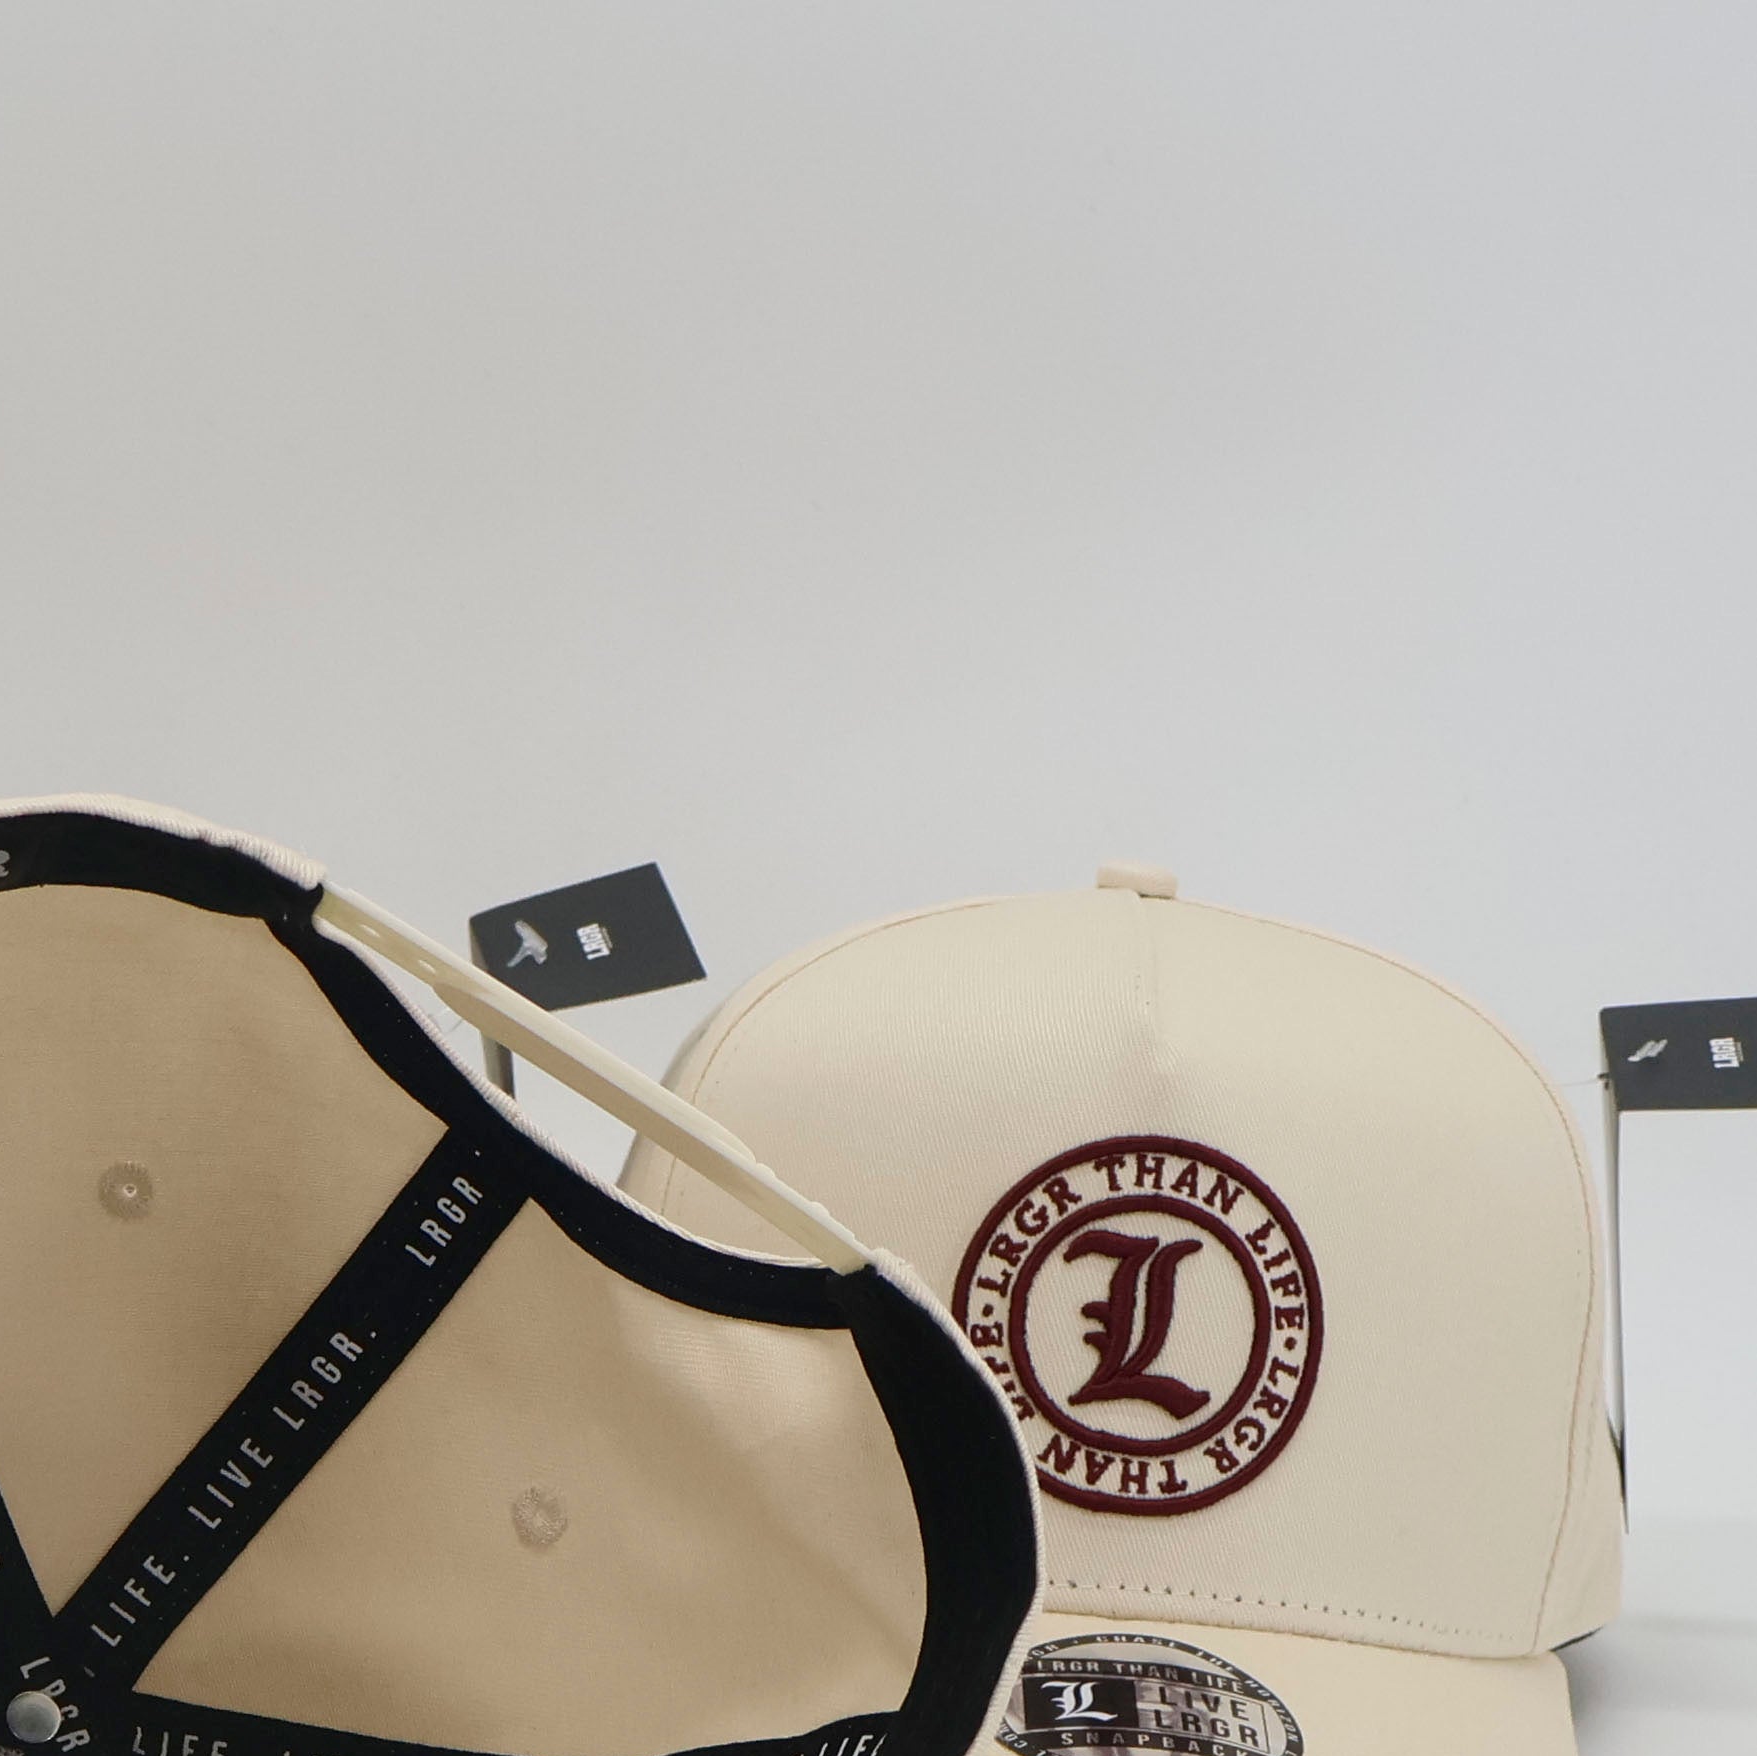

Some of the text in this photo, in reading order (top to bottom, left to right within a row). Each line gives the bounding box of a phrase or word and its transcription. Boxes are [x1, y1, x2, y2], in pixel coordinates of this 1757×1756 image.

[977, 1176, 1083, 1298] LRGR
[1094, 1153, 1246, 1215] THAN
[1063, 1229, 1211, 1420] L
[188, 1437, 274, 1530] LIVE
[1038, 1433, 1188, 1495] THAN
[1037, 1660, 1245, 1694] LRGR THAN LIFE
[1040, 1680, 1118, 1722] L
[1153, 1708, 1260, 1749] LRGR
[1158, 1685, 1250, 1722] LIVE
